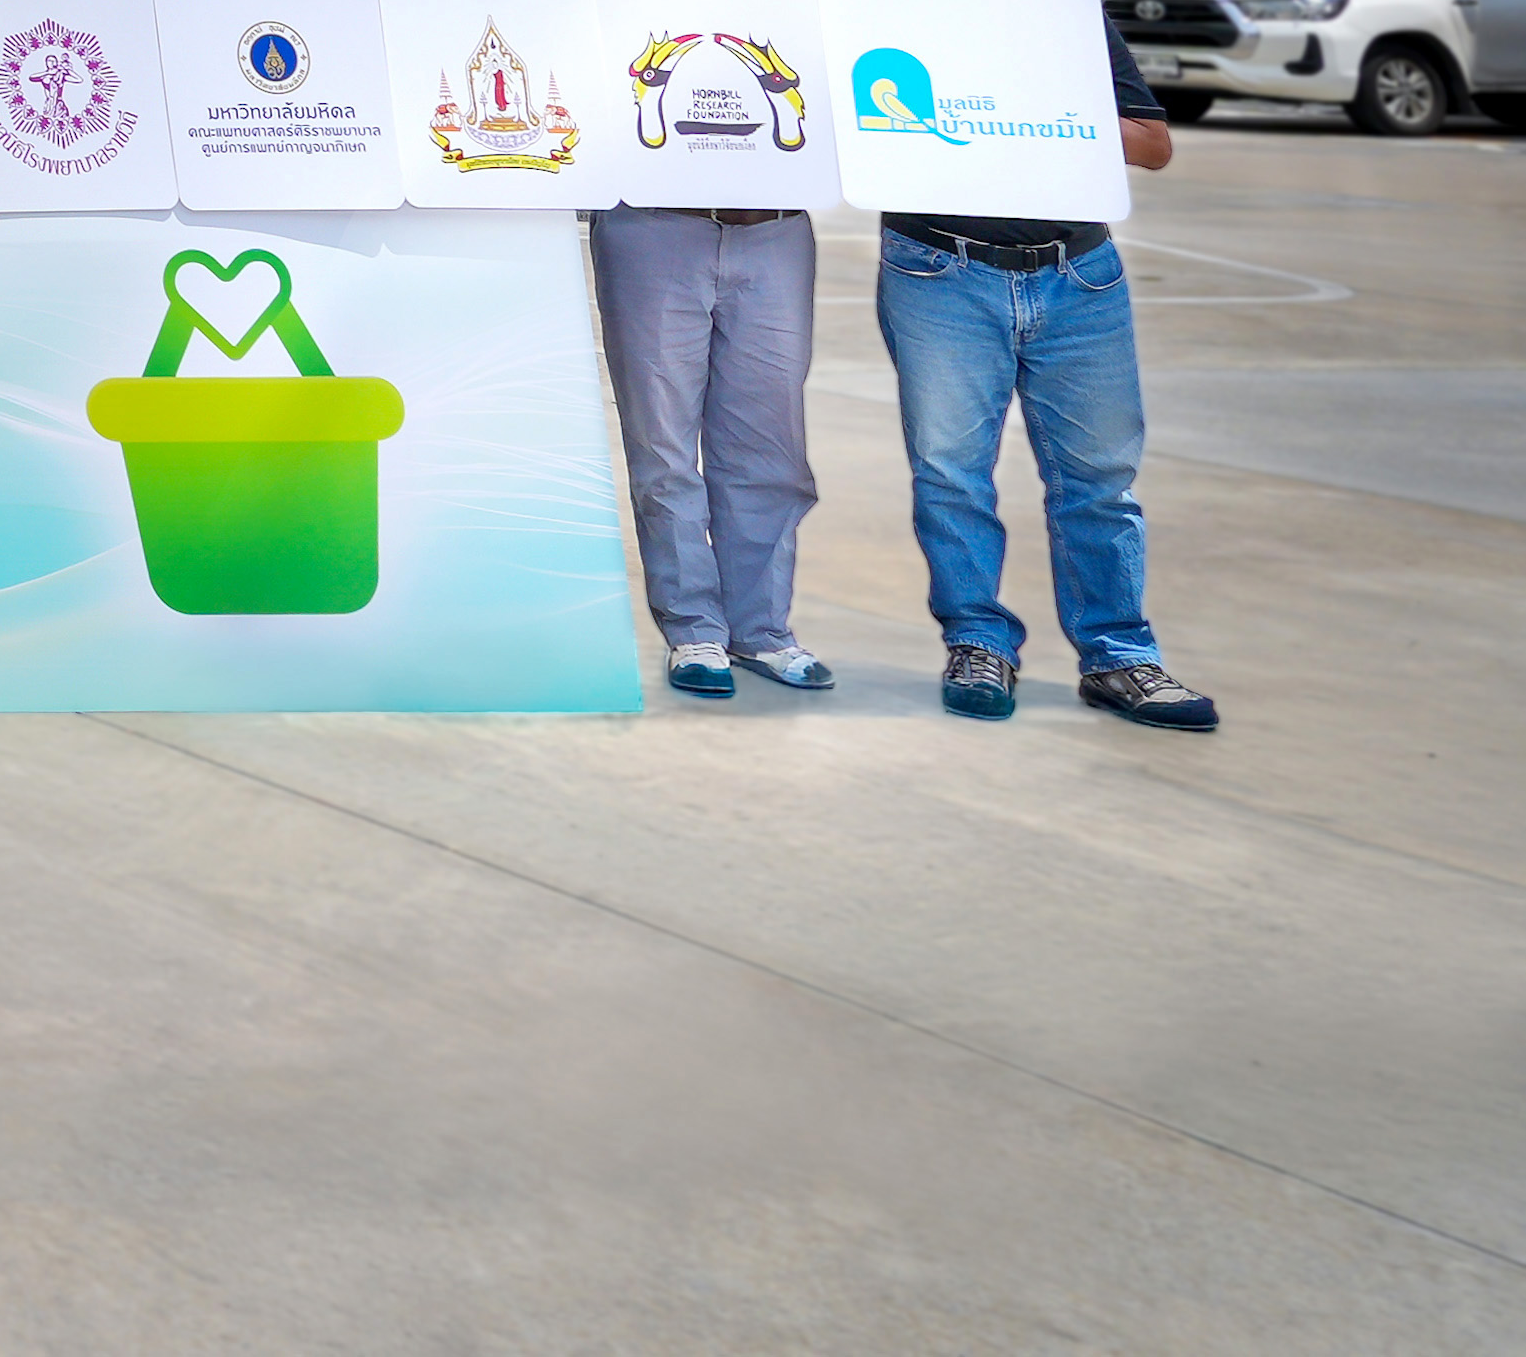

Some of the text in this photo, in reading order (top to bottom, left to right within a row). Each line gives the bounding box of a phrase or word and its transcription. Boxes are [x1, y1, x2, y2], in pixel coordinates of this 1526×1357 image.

[692, 89, 742, 100] HORNBILL
[207, 102, 356, 120] มหาวิทยาลัยมหิดล
[693, 100, 743, 111] RESEARCH
[938, 95, 996, 114] มูลนิธิ
[687, 109, 750, 121] FOUNDATION
[188, 124, 381, 138] คณะแพทยศาสตร์ศิริราชพยาบาล
[941, 112, 1097, 140] บ้านนกขมิ้น
[201, 140, 367, 158] ศูนย์การแพทย์กาญจนาภิเษก
